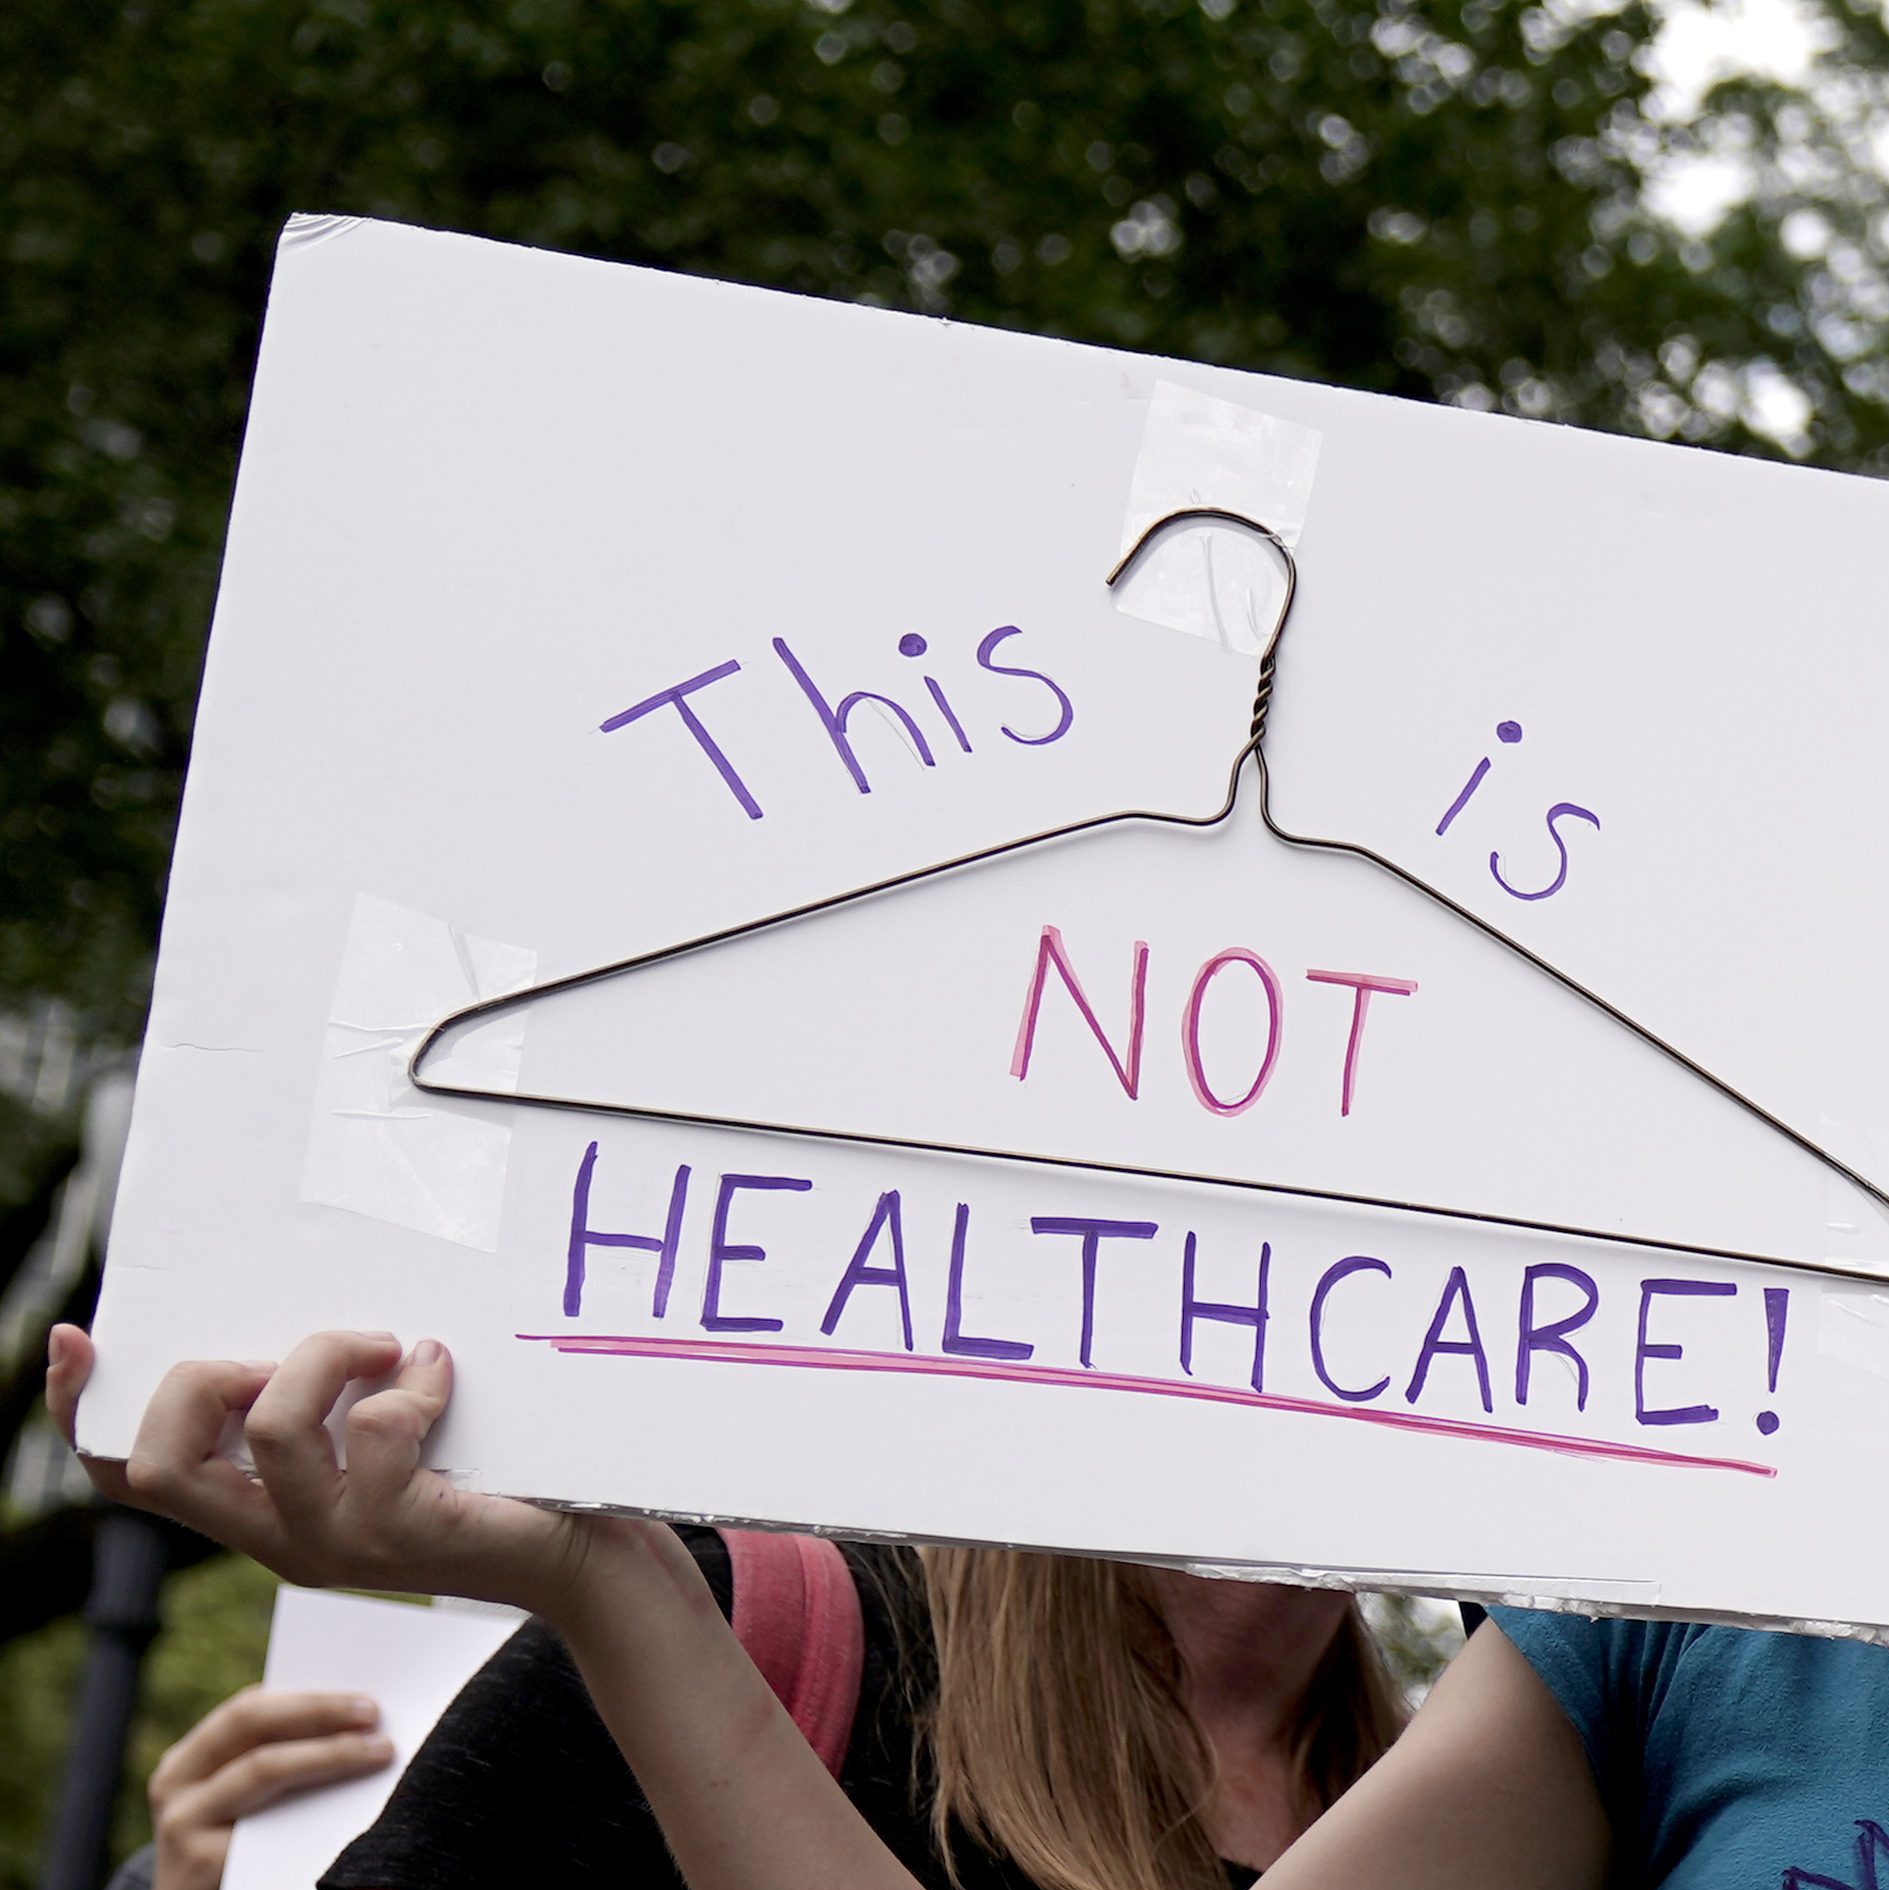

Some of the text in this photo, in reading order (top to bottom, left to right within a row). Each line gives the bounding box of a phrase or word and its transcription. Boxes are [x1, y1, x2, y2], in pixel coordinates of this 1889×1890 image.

[598, 623, 1600, 903] This is
[1011, 923, 1420, 1118] NOT
[564, 1142, 1789, 1436] HEALTHCARE!
